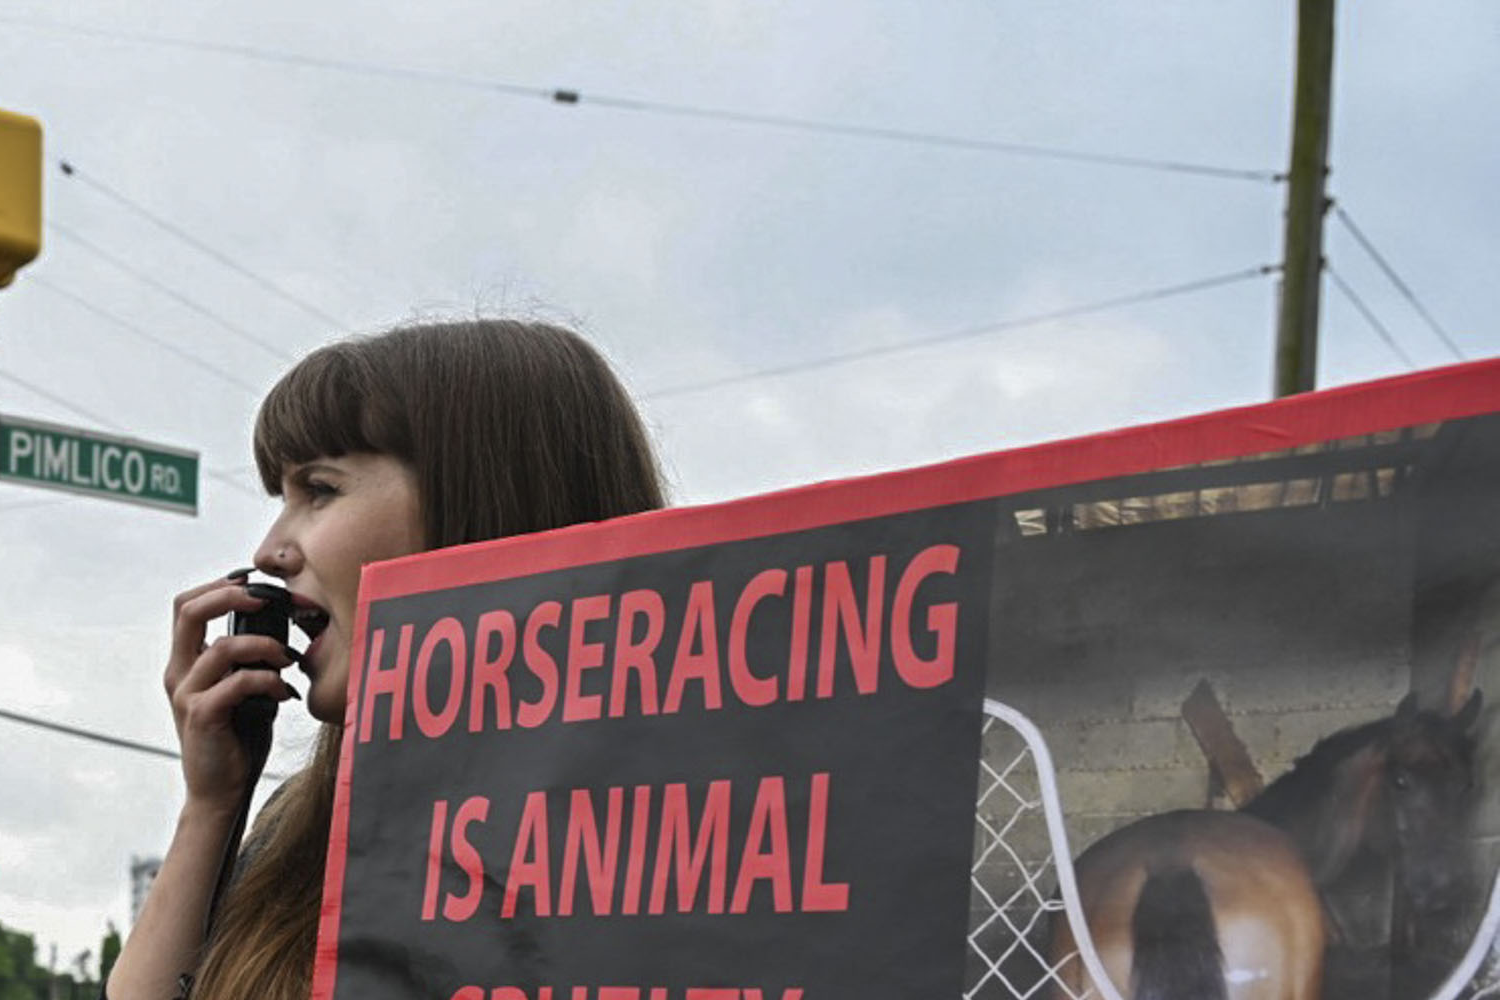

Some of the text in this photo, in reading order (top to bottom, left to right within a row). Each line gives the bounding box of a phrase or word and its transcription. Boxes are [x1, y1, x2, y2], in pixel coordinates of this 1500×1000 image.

[9, 430, 145, 495] PIMLICO
[357, 543, 960, 743] HORSERACING
[421, 772, 850, 922] IS ANIMAL
